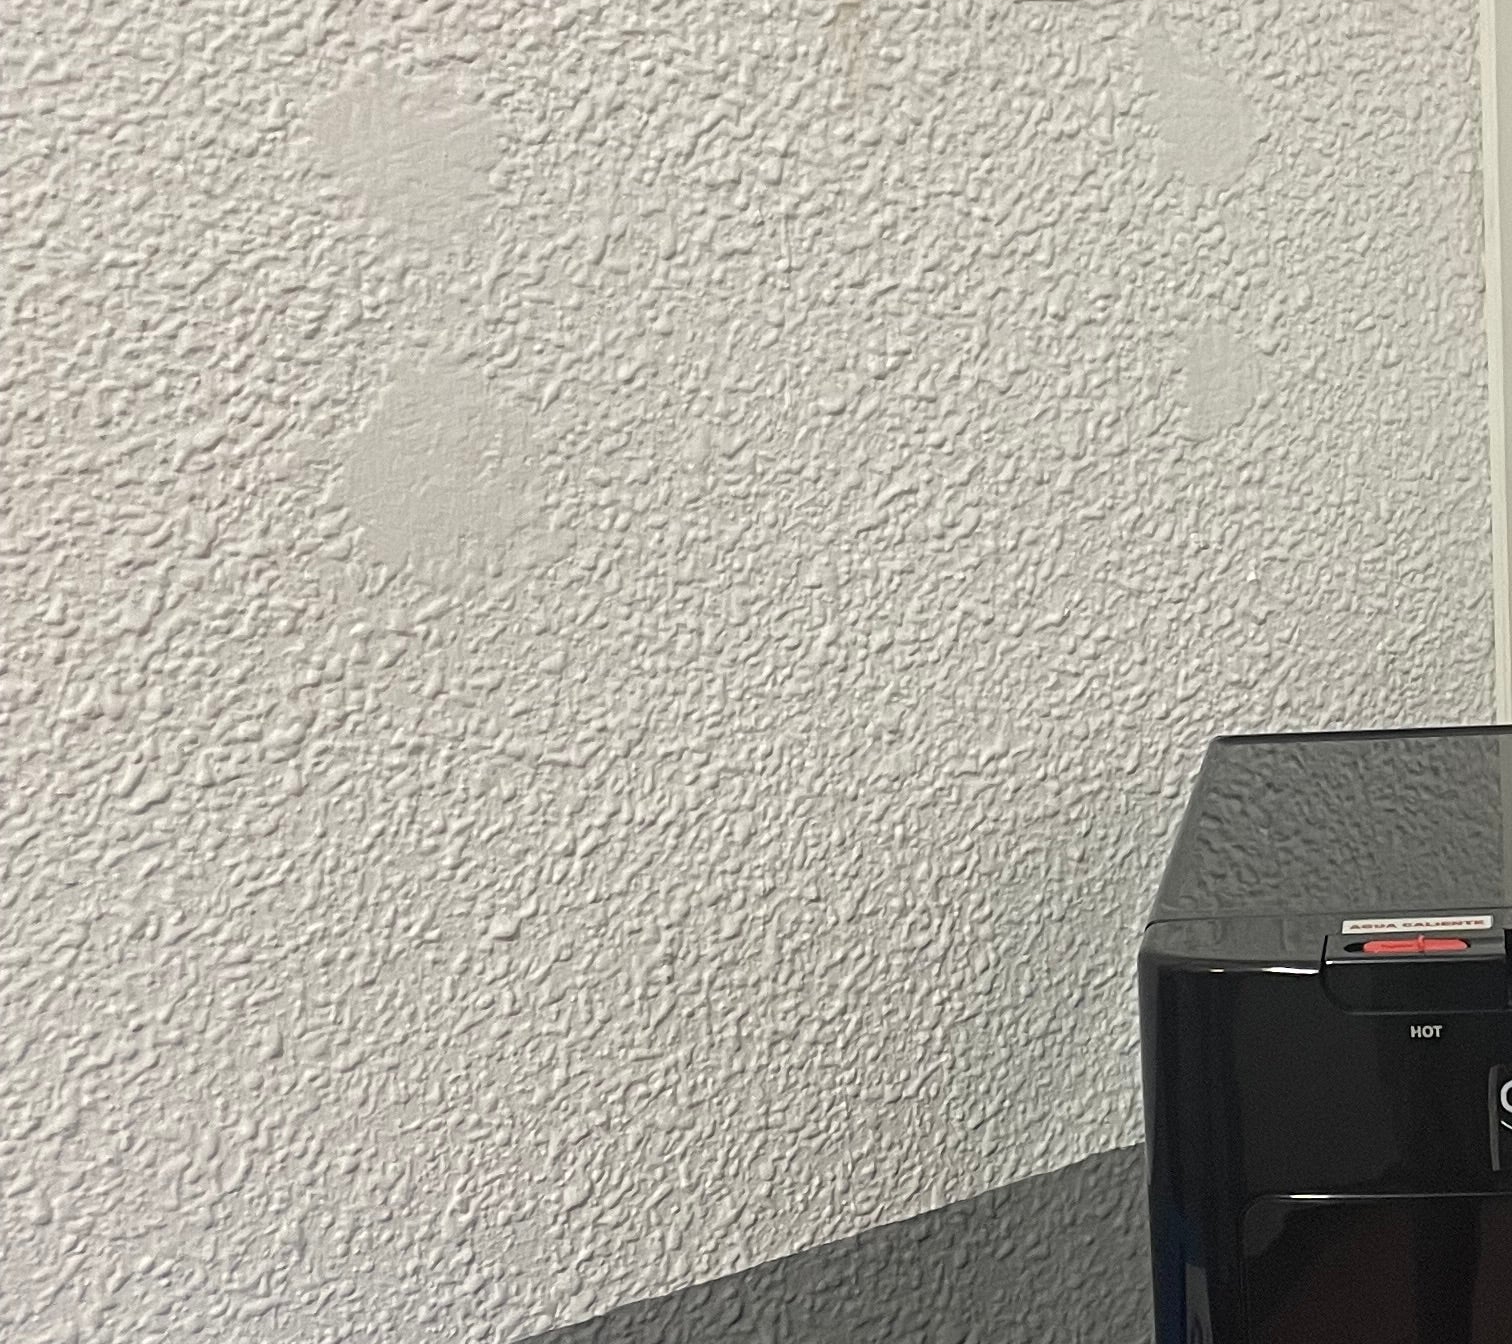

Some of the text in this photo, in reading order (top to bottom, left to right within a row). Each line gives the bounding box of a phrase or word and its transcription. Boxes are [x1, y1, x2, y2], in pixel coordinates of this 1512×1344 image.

[1350, 918, 1486, 931] AGUA CALIENTE
[1410, 1024, 1443, 1038] HOT
